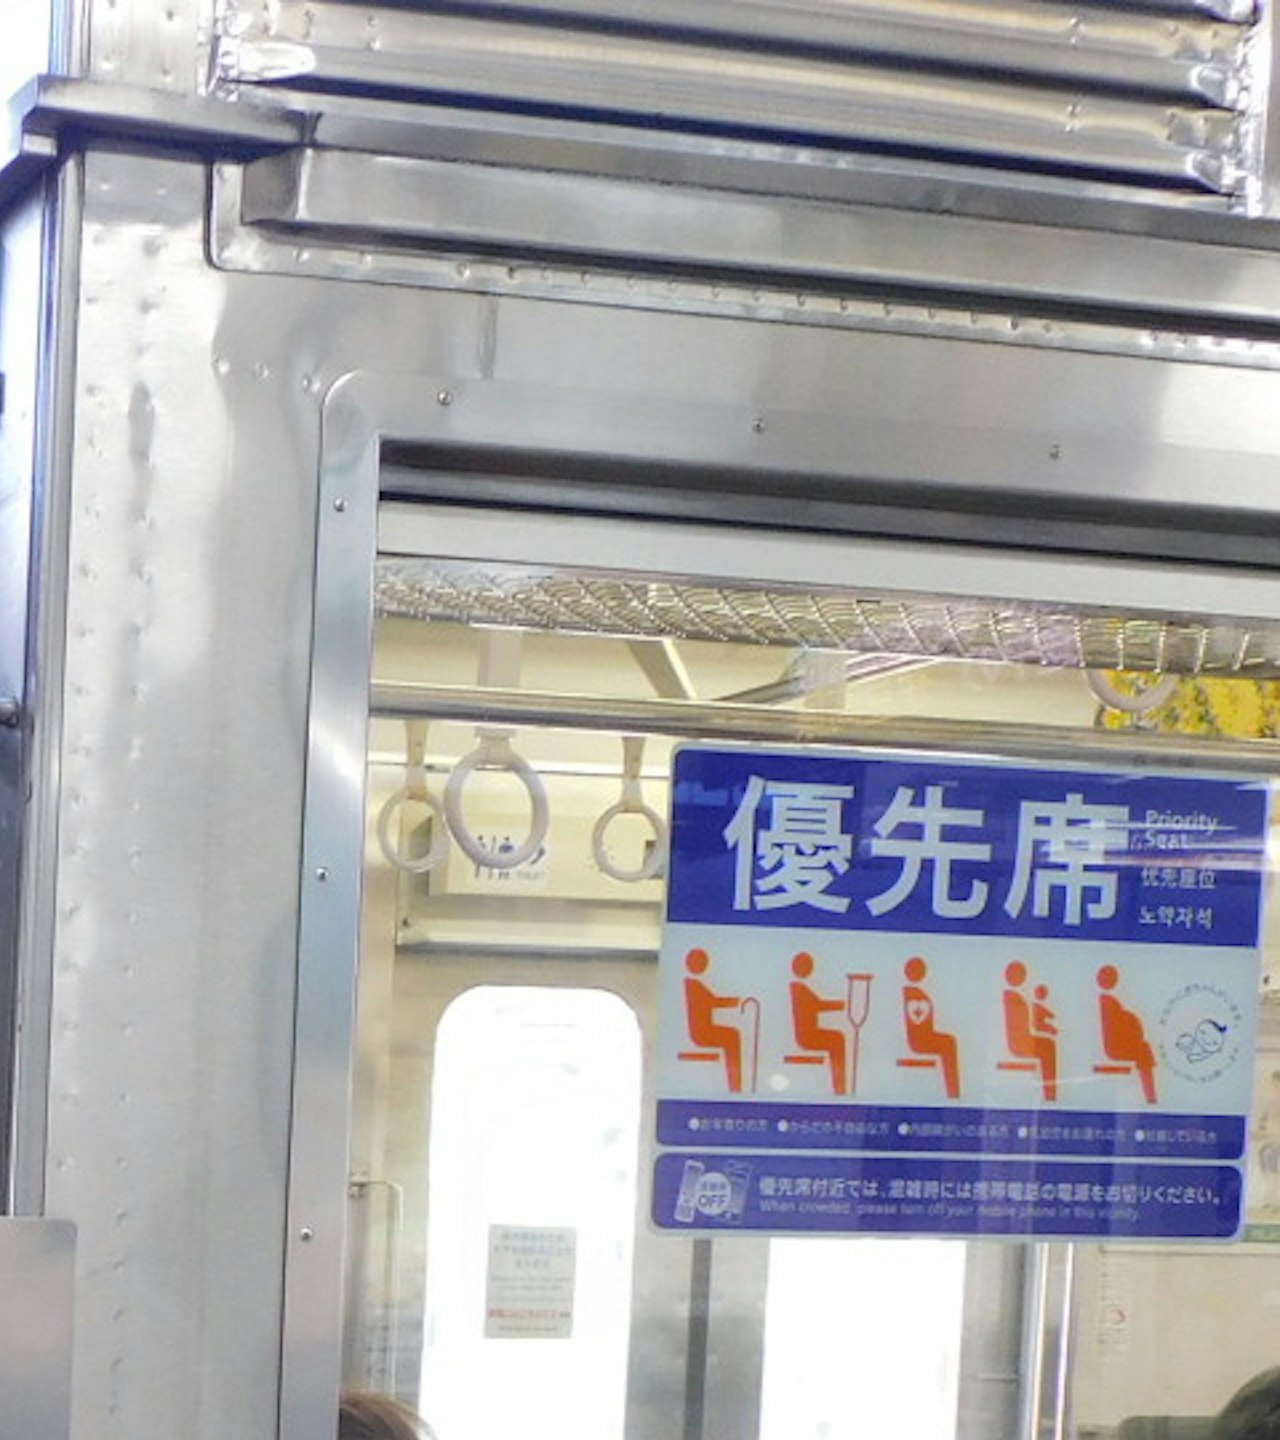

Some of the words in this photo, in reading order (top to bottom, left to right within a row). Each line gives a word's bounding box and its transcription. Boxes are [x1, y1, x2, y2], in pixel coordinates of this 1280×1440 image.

[1145, 810, 1218, 835] Priority
[1144, 829, 1188, 849] Seat
[725, 776, 1130, 927] 優先席
[698, 1194, 728, 1209] OFF
